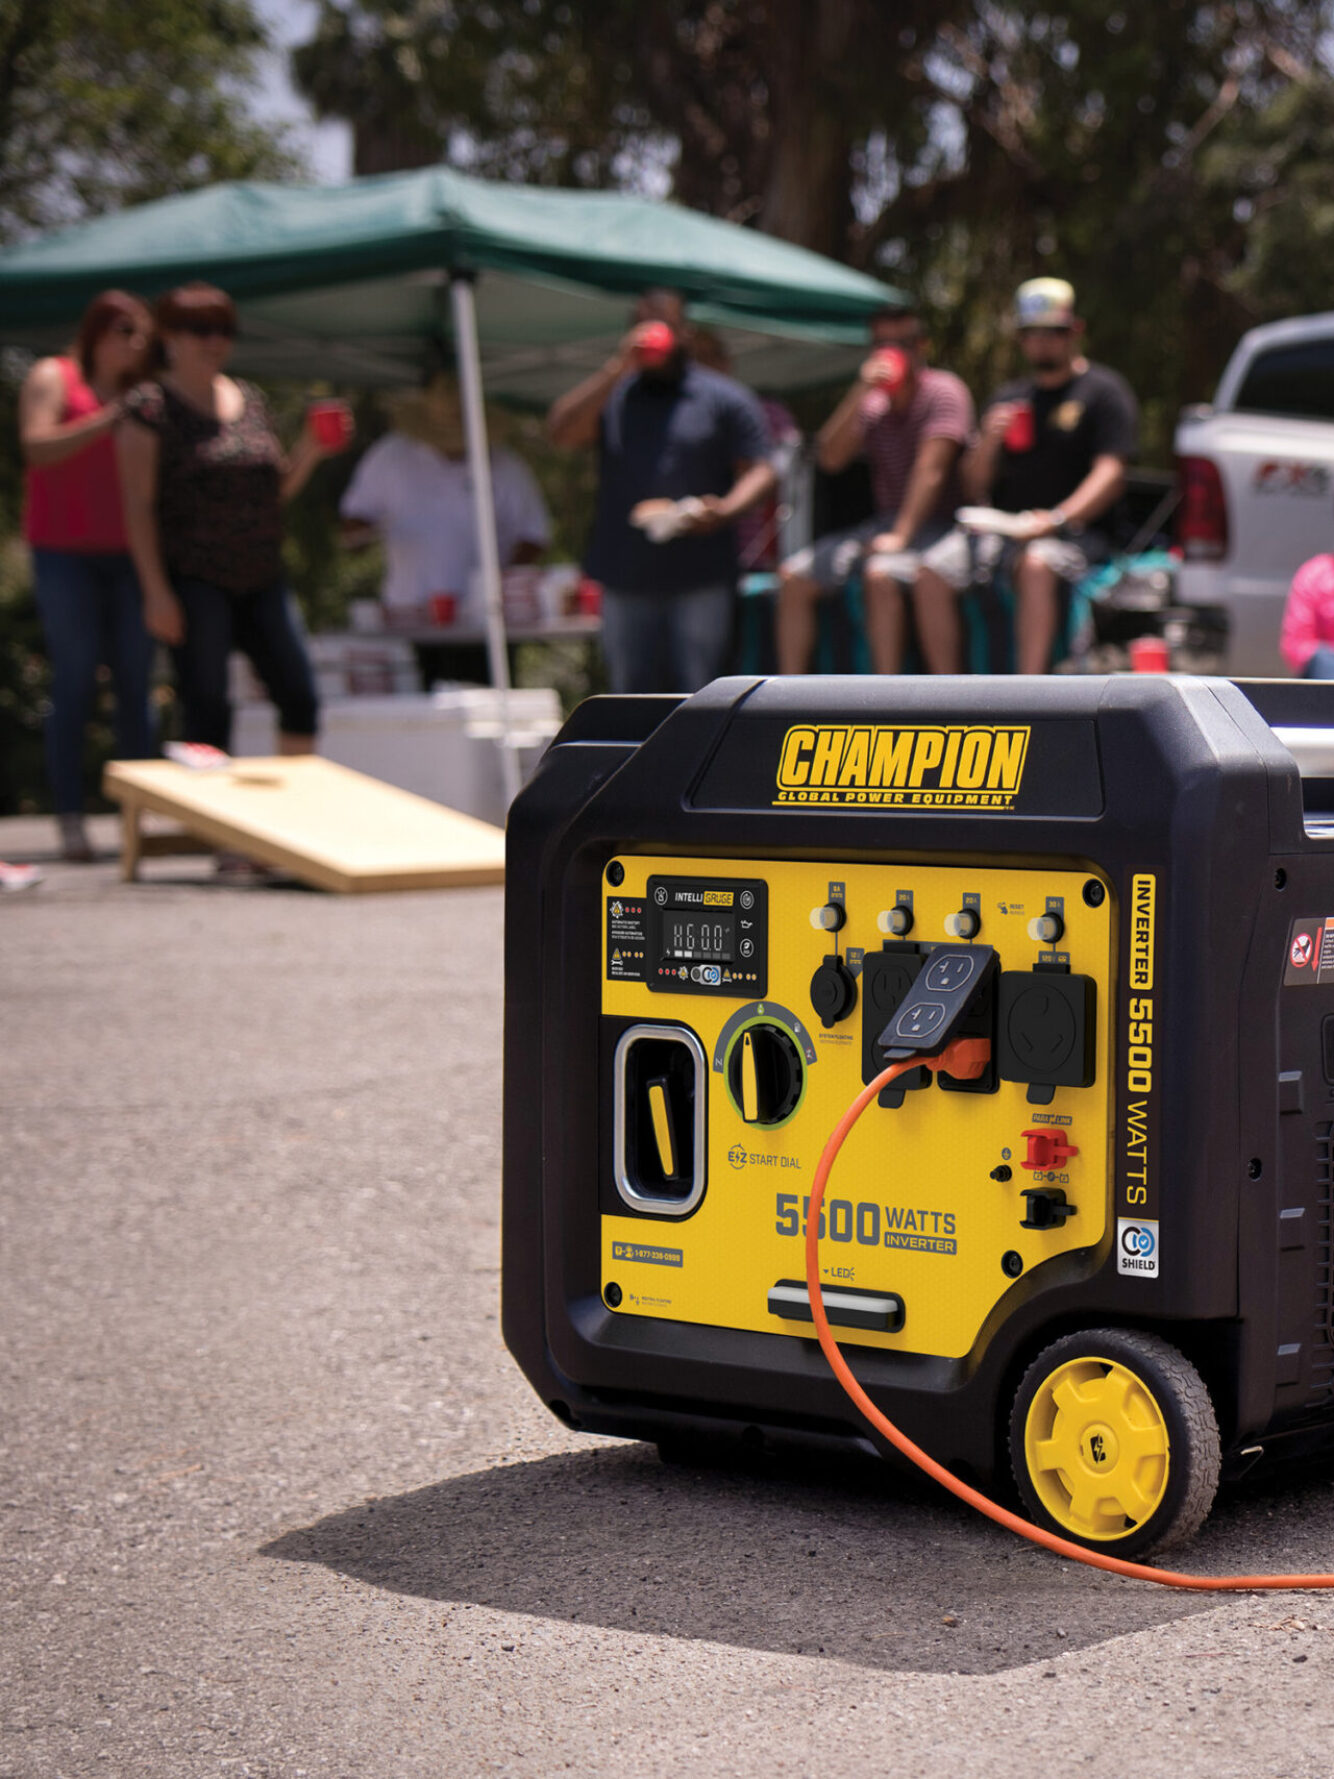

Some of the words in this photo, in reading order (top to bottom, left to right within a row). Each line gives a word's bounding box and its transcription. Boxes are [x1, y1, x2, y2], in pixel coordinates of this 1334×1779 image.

[779, 729, 1026, 790] CHAMPION
[777, 791, 840, 802] GLOBAL
[844, 793, 904, 804] POWER
[912, 793, 1013, 806] EQUIPMENT
[1134, 880, 1152, 985] INVERTER
[1128, 998, 1153, 1093] 5500
[749, 1153, 778, 1167] START
[780, 1156, 802, 1169] DIAL
[1126, 1100, 1148, 1205] WATTS
[884, 1206, 957, 1235] WATTS
[886, 1233, 955, 1253] INVERTER
[831, 1266, 850, 1279] LED
[1121, 1257, 1156, 1271] SHIELD
